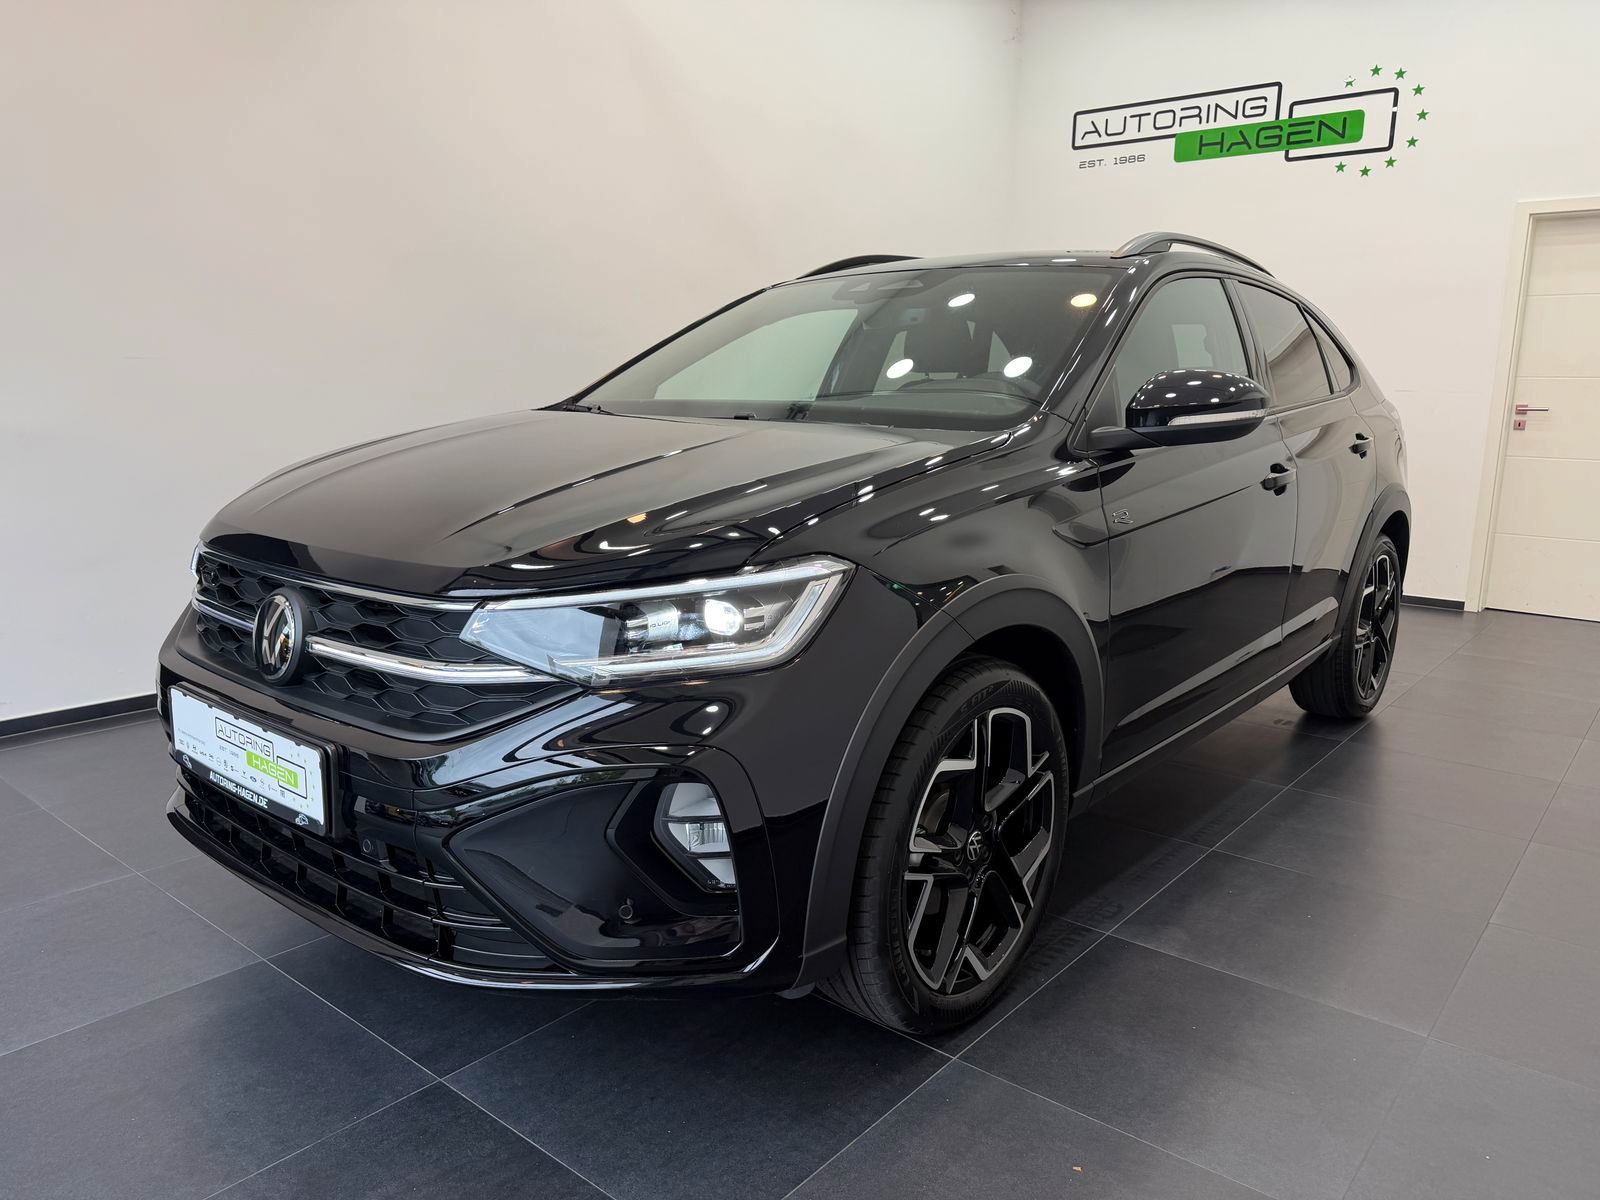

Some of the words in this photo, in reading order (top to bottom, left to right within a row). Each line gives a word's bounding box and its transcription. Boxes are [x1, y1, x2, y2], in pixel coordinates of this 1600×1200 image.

[1080, 96, 1268, 140] AUTORING
[1198, 116, 1347, 156] HAGEN
[1078, 158, 1108, 169] EST.
[1113, 154, 1146, 166] 1986
[217, 723, 272, 758] AUTORING
[251, 755, 296, 786] HAGEN
